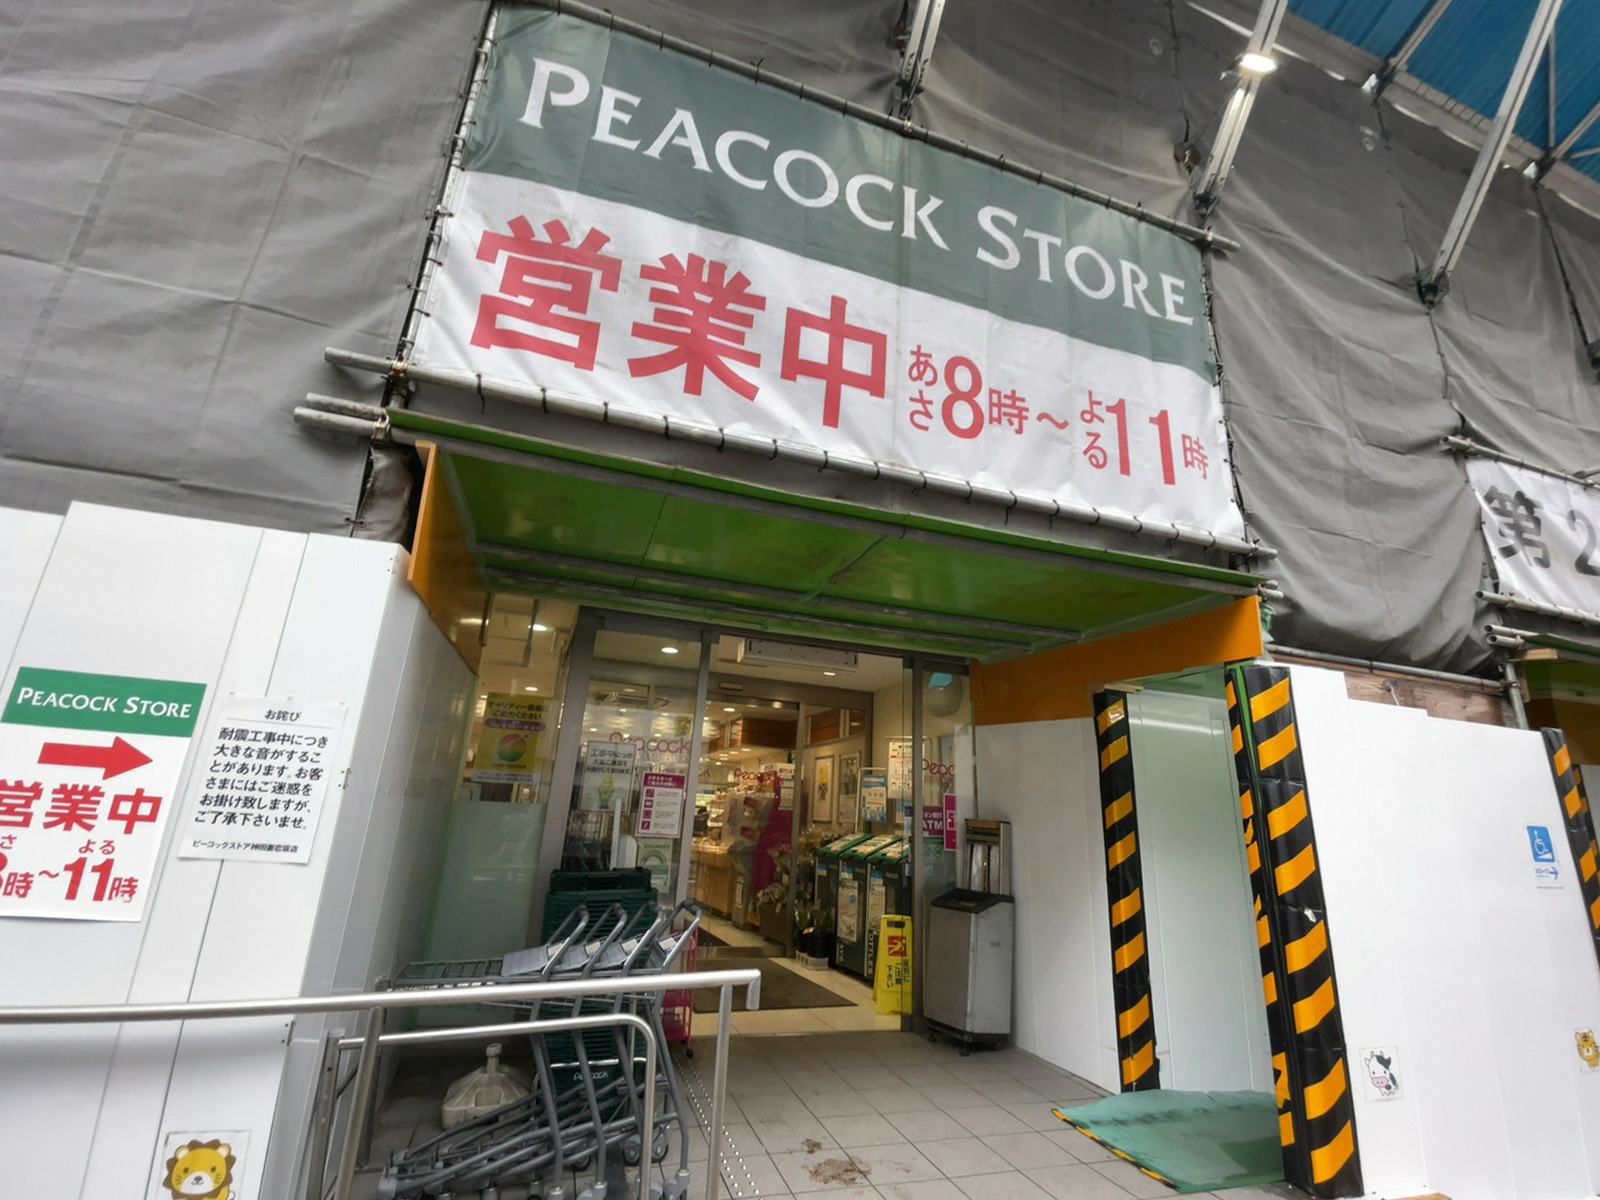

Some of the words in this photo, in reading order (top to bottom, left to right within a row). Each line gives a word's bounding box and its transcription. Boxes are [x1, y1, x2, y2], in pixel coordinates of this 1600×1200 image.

[518, 57, 950, 251] PEACOCK
[976, 204, 1194, 326] STORE
[469, 214, 887, 428] 営業中
[17, 687, 119, 713] PEACOCK
[123, 696, 192, 719] STORE
[265, 709, 301, 722] お詫び
[218, 727, 328, 748] 耐震工事中につき
[214, 744, 322, 763] 大きな音がするこ
[209, 760, 324, 781] とがあります。お客
[205, 777, 313, 796] さまにはご迷惑を
[0, 779, 163, 835] 営業中
[200, 794, 311, 813] お掛け致しますが、
[194, 810, 306, 830] ご了承下さいませ。
[78, 839, 116, 855] よる
